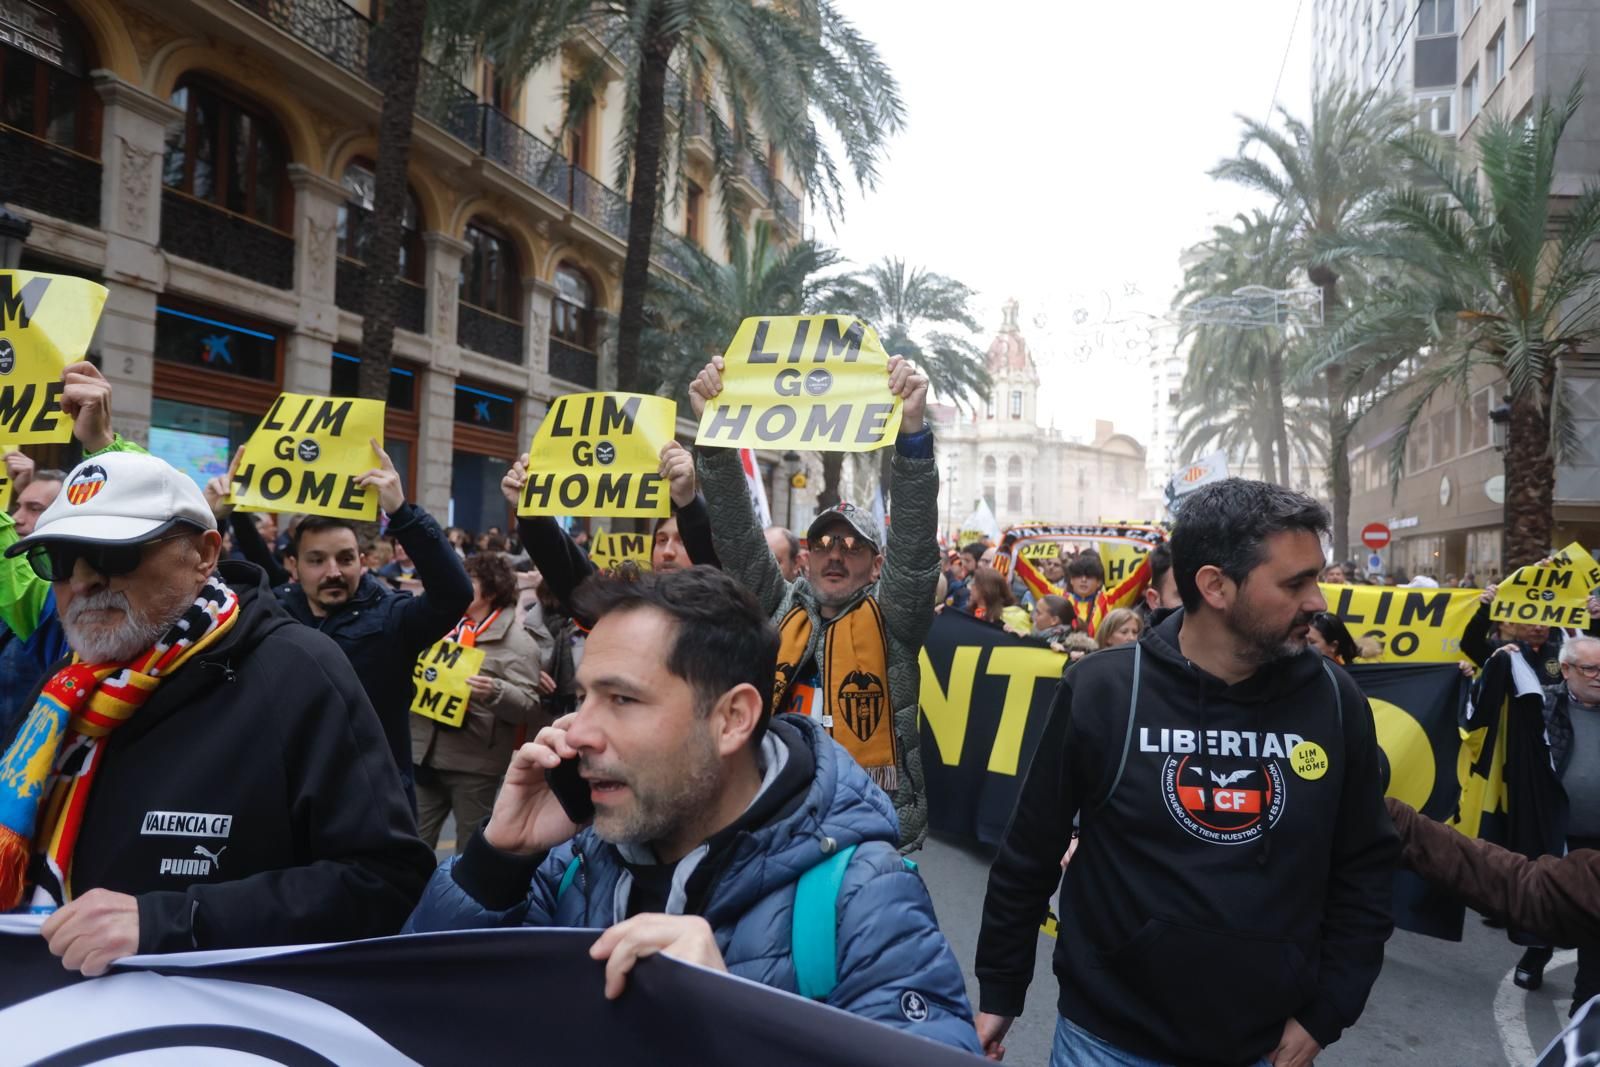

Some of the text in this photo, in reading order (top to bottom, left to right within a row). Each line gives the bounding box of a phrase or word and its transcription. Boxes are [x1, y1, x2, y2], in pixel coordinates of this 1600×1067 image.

[747, 319, 865, 363] LIM
[263, 396, 353, 437] LIM
[551, 396, 642, 437] LIM
[704, 403, 894, 443] HOME
[524, 473, 664, 509] HOME
[596, 533, 644, 556] LIM
[1512, 569, 1573, 589] LIM
[1336, 588, 1452, 627] LIM
[1494, 601, 1586, 625] HOME
[1140, 727, 1304, 759] LIBERTAD
[1168, 759, 1178, 768] EL
[1299, 749, 1317, 760] LIM
[1299, 761, 1326, 773] HOME
[1168, 793, 1185, 818] DUEÑO
[1270, 804, 1279, 815] ES
[1274, 794, 1281, 805] SU
[146, 814, 229, 834] VALENCIA CF
[1184, 817, 1198, 830] QUE
[1198, 827, 1220, 840] TIENE
[1221, 828, 1257, 841] NUESTRO
[160, 858, 211, 875] PUMA
